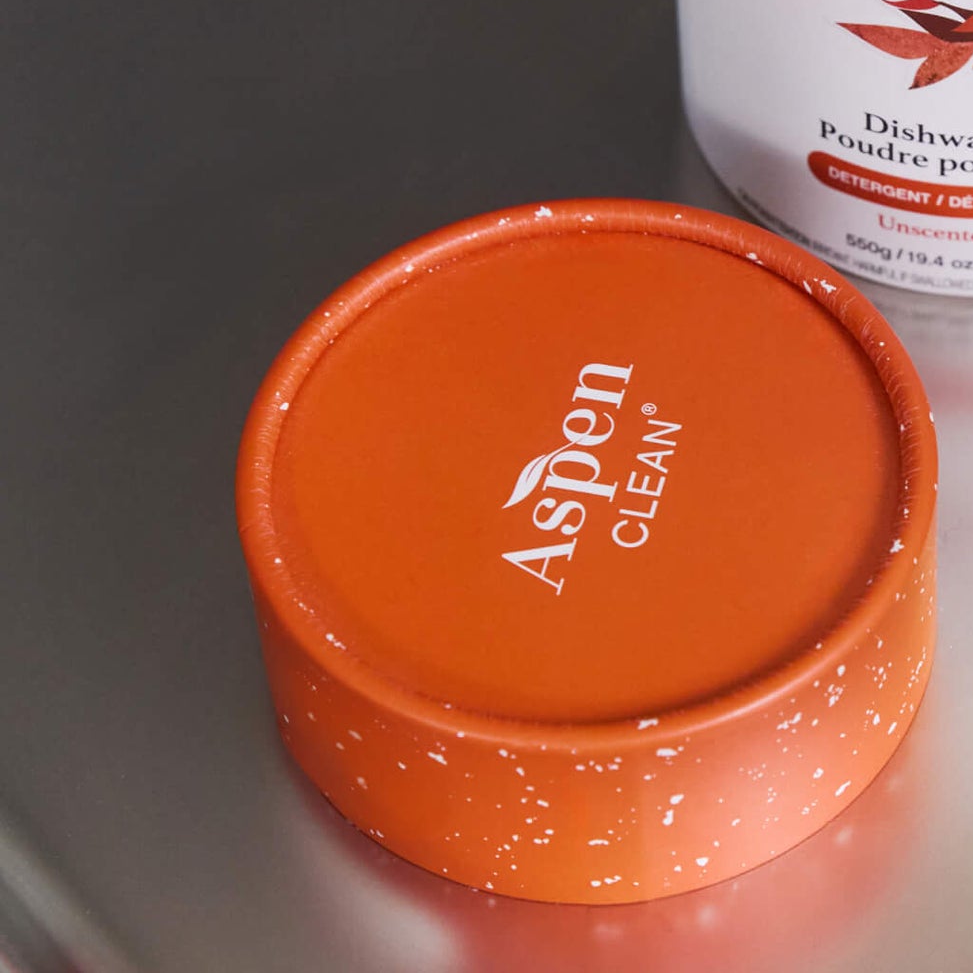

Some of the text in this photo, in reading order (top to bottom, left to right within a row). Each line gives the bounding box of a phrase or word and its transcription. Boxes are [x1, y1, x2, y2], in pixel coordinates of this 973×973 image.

[819, 119, 929, 168] Poudre
[828, 165, 931, 205] DETERGENT
[845, 232, 892, 261] 550g
[908, 250, 944, 267] 19.4
[951, 258, 973, 270] oz
[501, 363, 634, 596] Aspen
